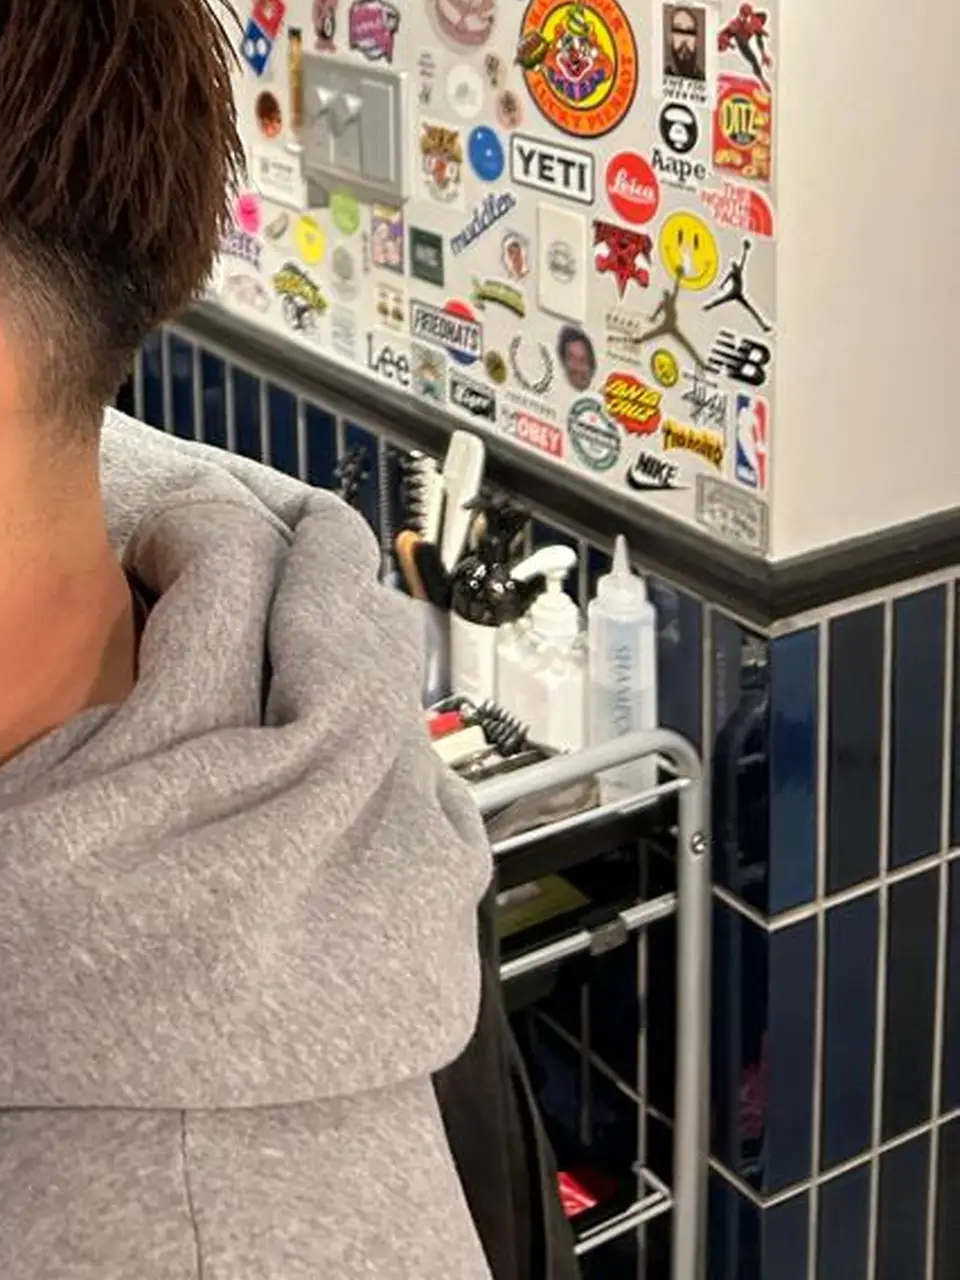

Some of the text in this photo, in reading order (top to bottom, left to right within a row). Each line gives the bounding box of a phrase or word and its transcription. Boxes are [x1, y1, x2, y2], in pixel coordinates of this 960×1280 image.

[517, 146, 587, 192] YETI
[652, 147, 706, 182] Aape
[366, 331, 410, 387] Lee
[518, 414, 562, 455] OBEY
[637, 452, 678, 483] NIKE
[610, 644, 632, 735] SHAMPO
